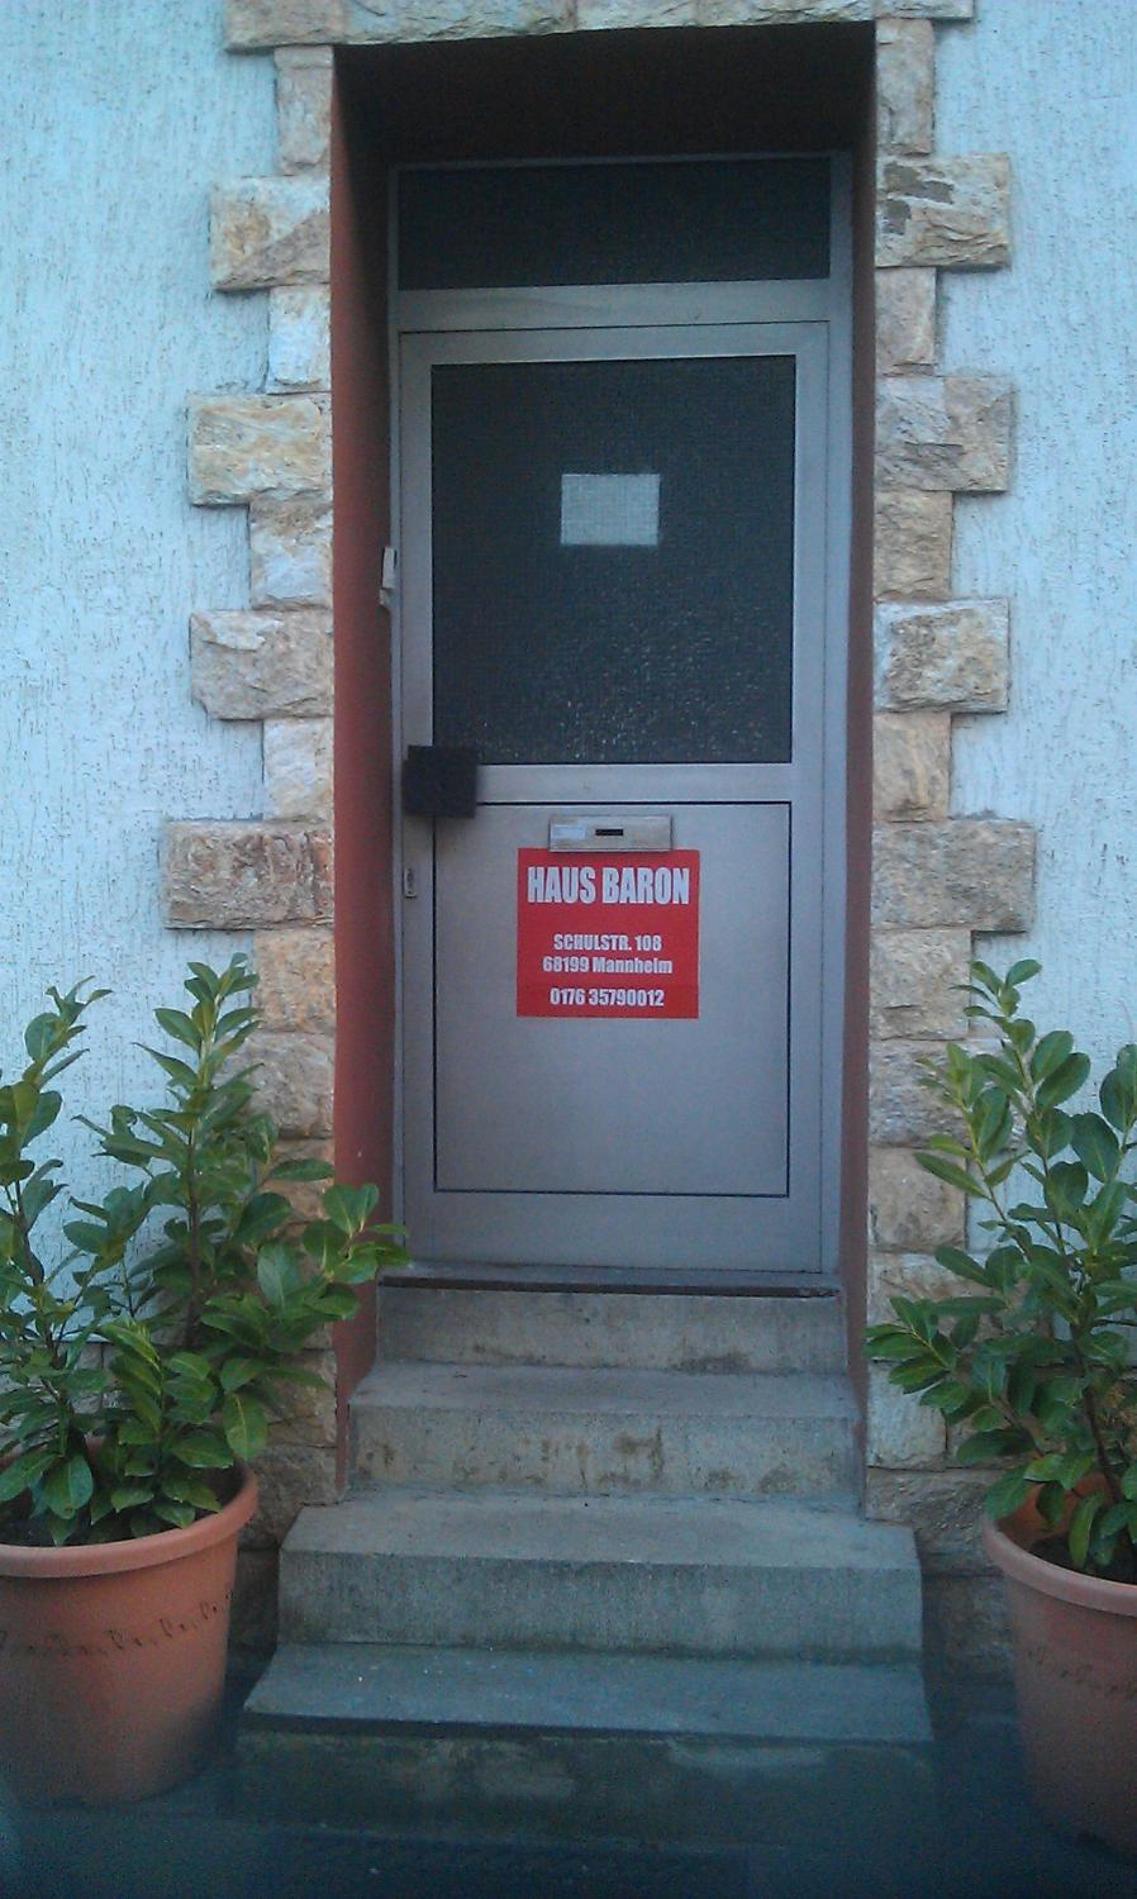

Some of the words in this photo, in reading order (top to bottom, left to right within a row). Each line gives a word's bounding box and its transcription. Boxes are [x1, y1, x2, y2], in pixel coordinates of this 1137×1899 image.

[527, 866, 596, 904] HAUS
[602, 867, 690, 905] BARON
[553, 933, 632, 951] SCHULSTR.
[634, 934, 662, 952] 108
[542, 956, 590, 973] 68199
[592, 956, 673, 974] Mannheim
[550, 988, 586, 1005] 0176
[588, 988, 665, 1007] 35790012
